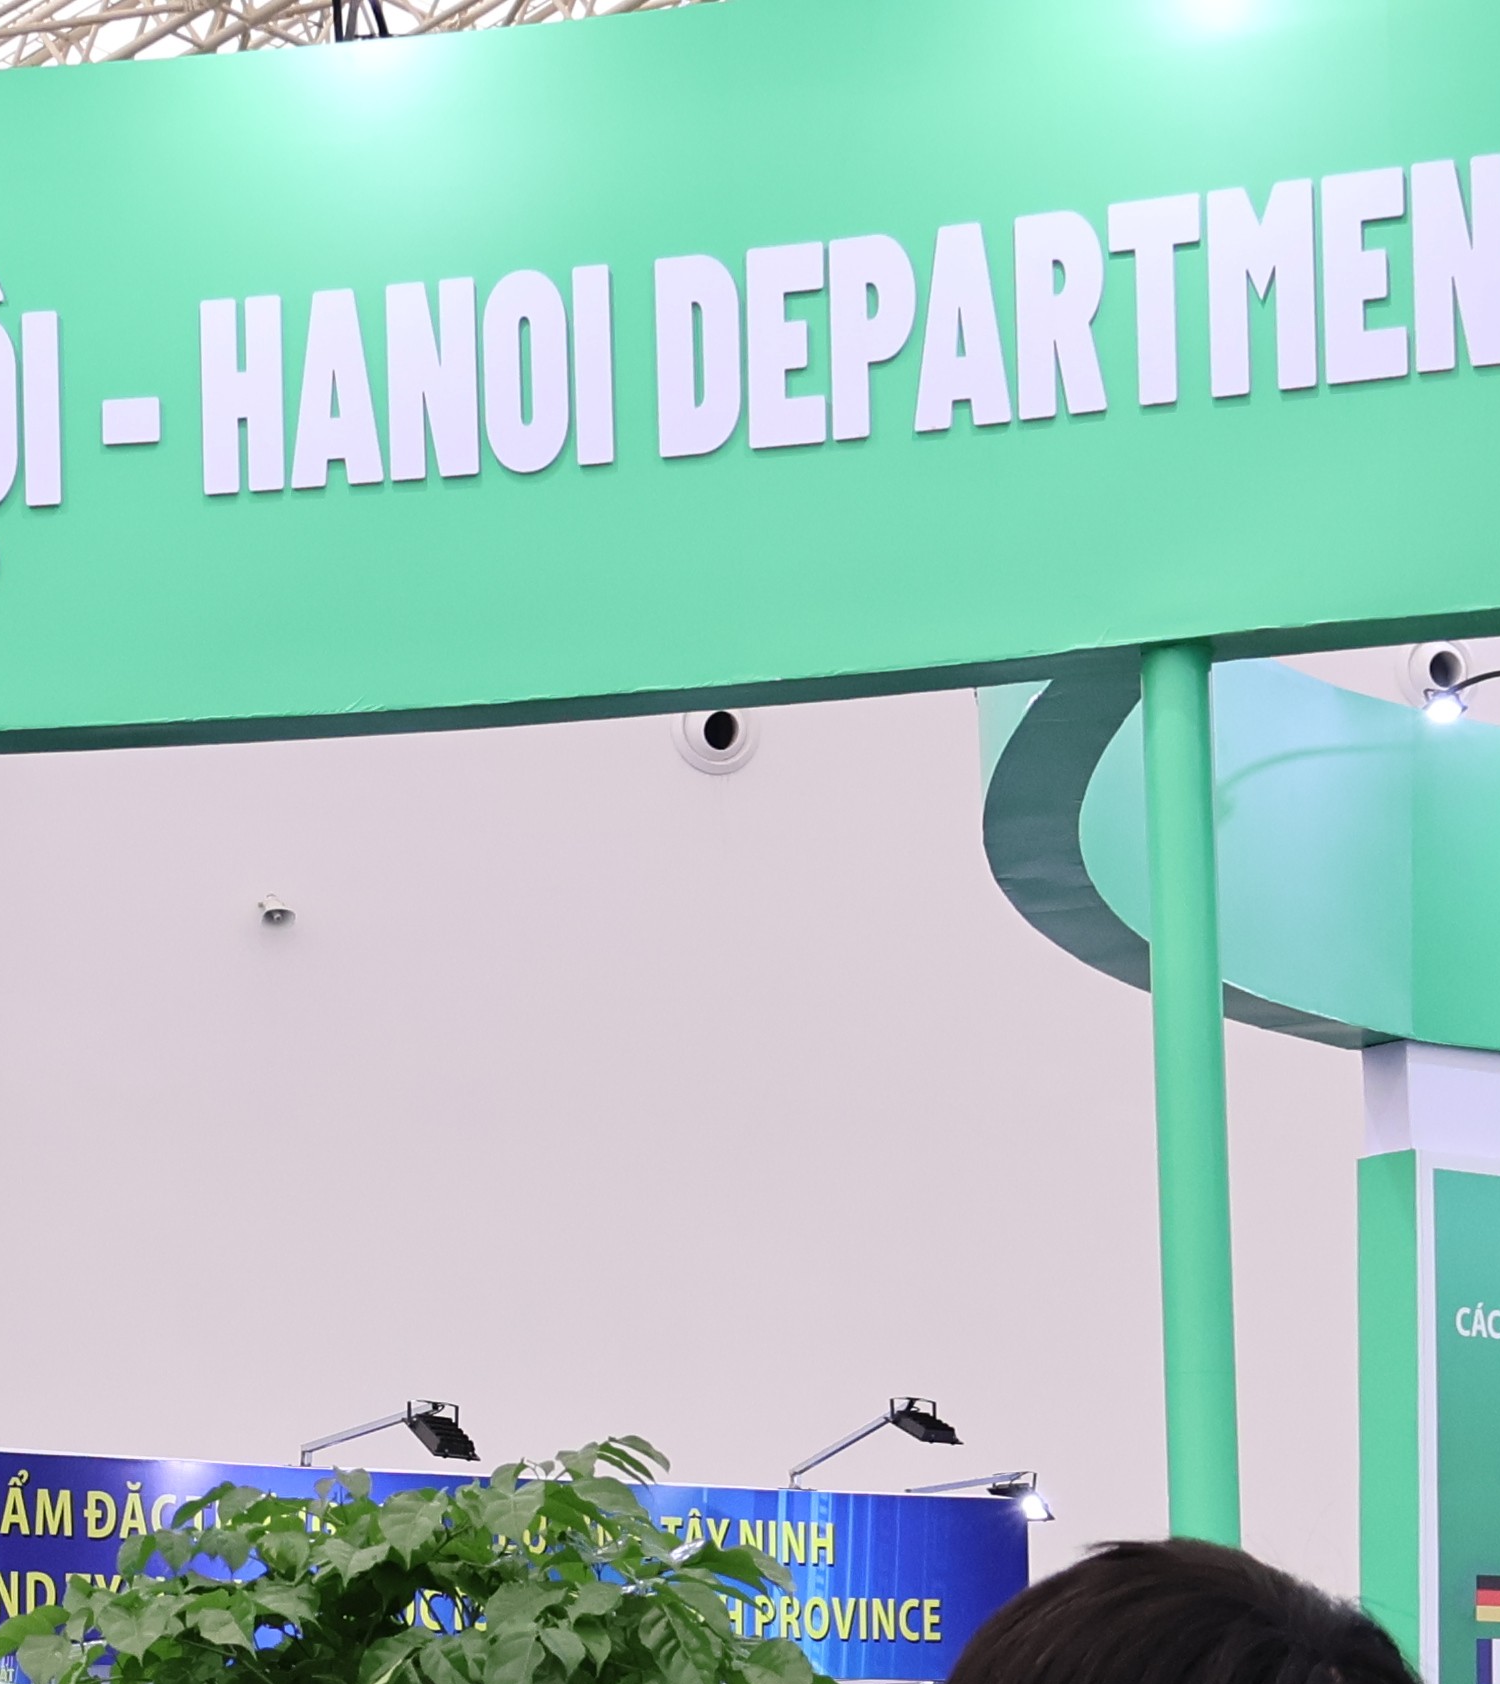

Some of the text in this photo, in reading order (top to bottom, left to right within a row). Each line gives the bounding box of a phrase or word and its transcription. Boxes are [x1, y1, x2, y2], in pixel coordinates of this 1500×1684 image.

[101, 396, 160, 447] -
[199, 263, 615, 496] HANOI
[660, 1508, 835, 1567] TÂY NINH
[754, 1595, 942, 1644] PROVINCE
